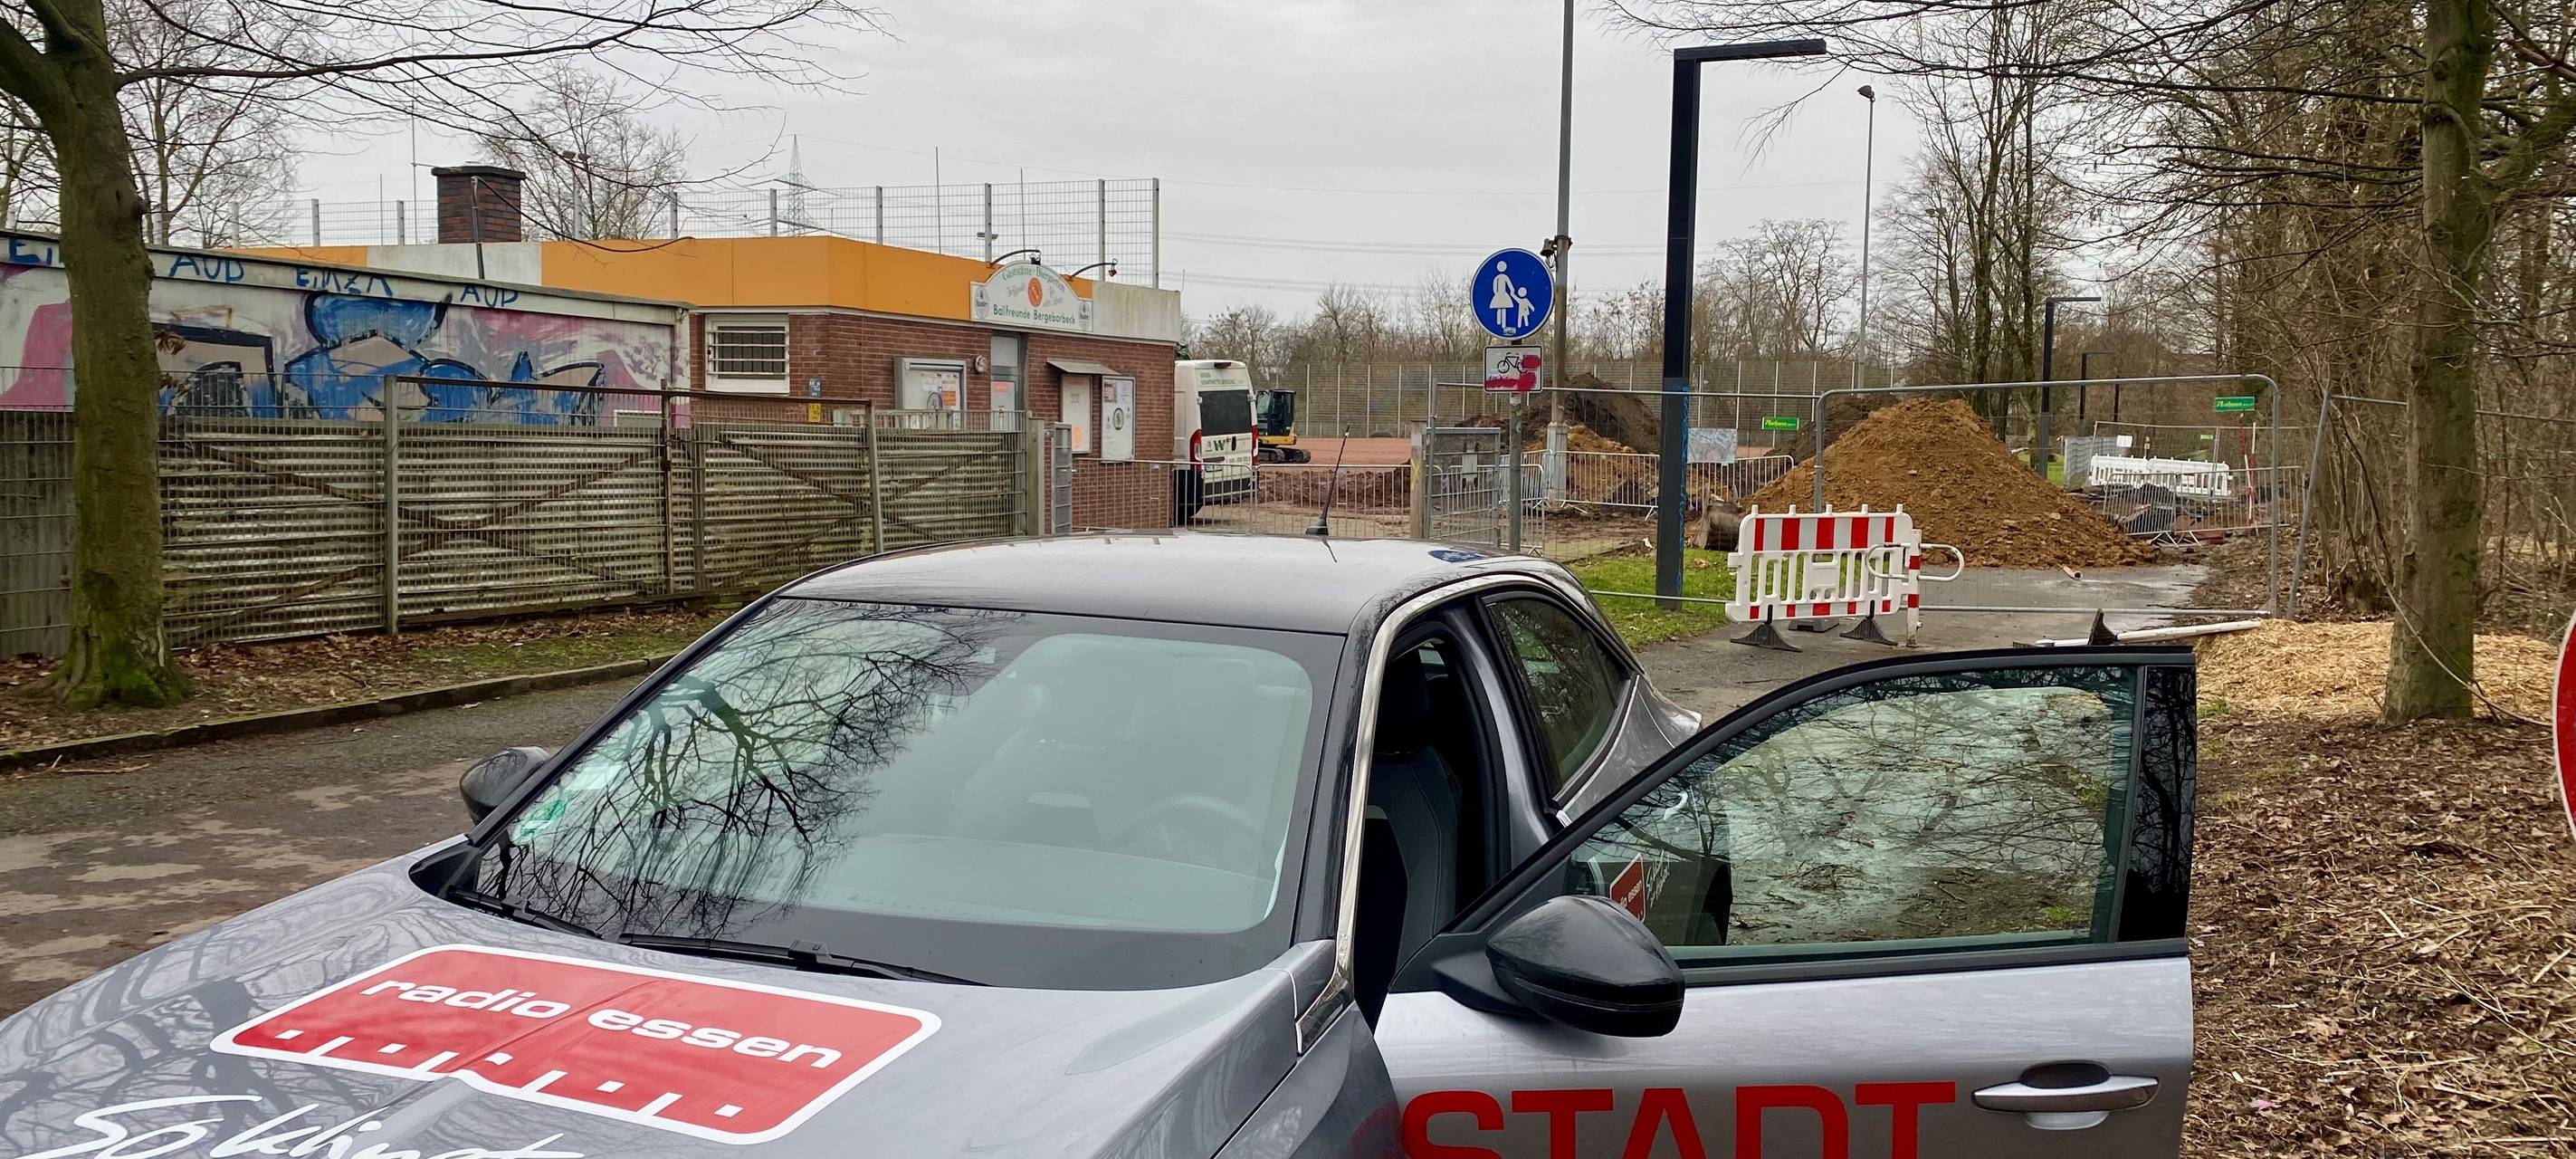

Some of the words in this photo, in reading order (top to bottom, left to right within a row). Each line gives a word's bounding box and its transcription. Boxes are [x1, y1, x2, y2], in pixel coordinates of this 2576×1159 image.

[993, 303, 1031, 320] Ballfreunde
[1033, 309, 1075, 324] Bergeborbeck
[359, 979, 571, 1019] radio
[587, 1008, 843, 1068] essen
